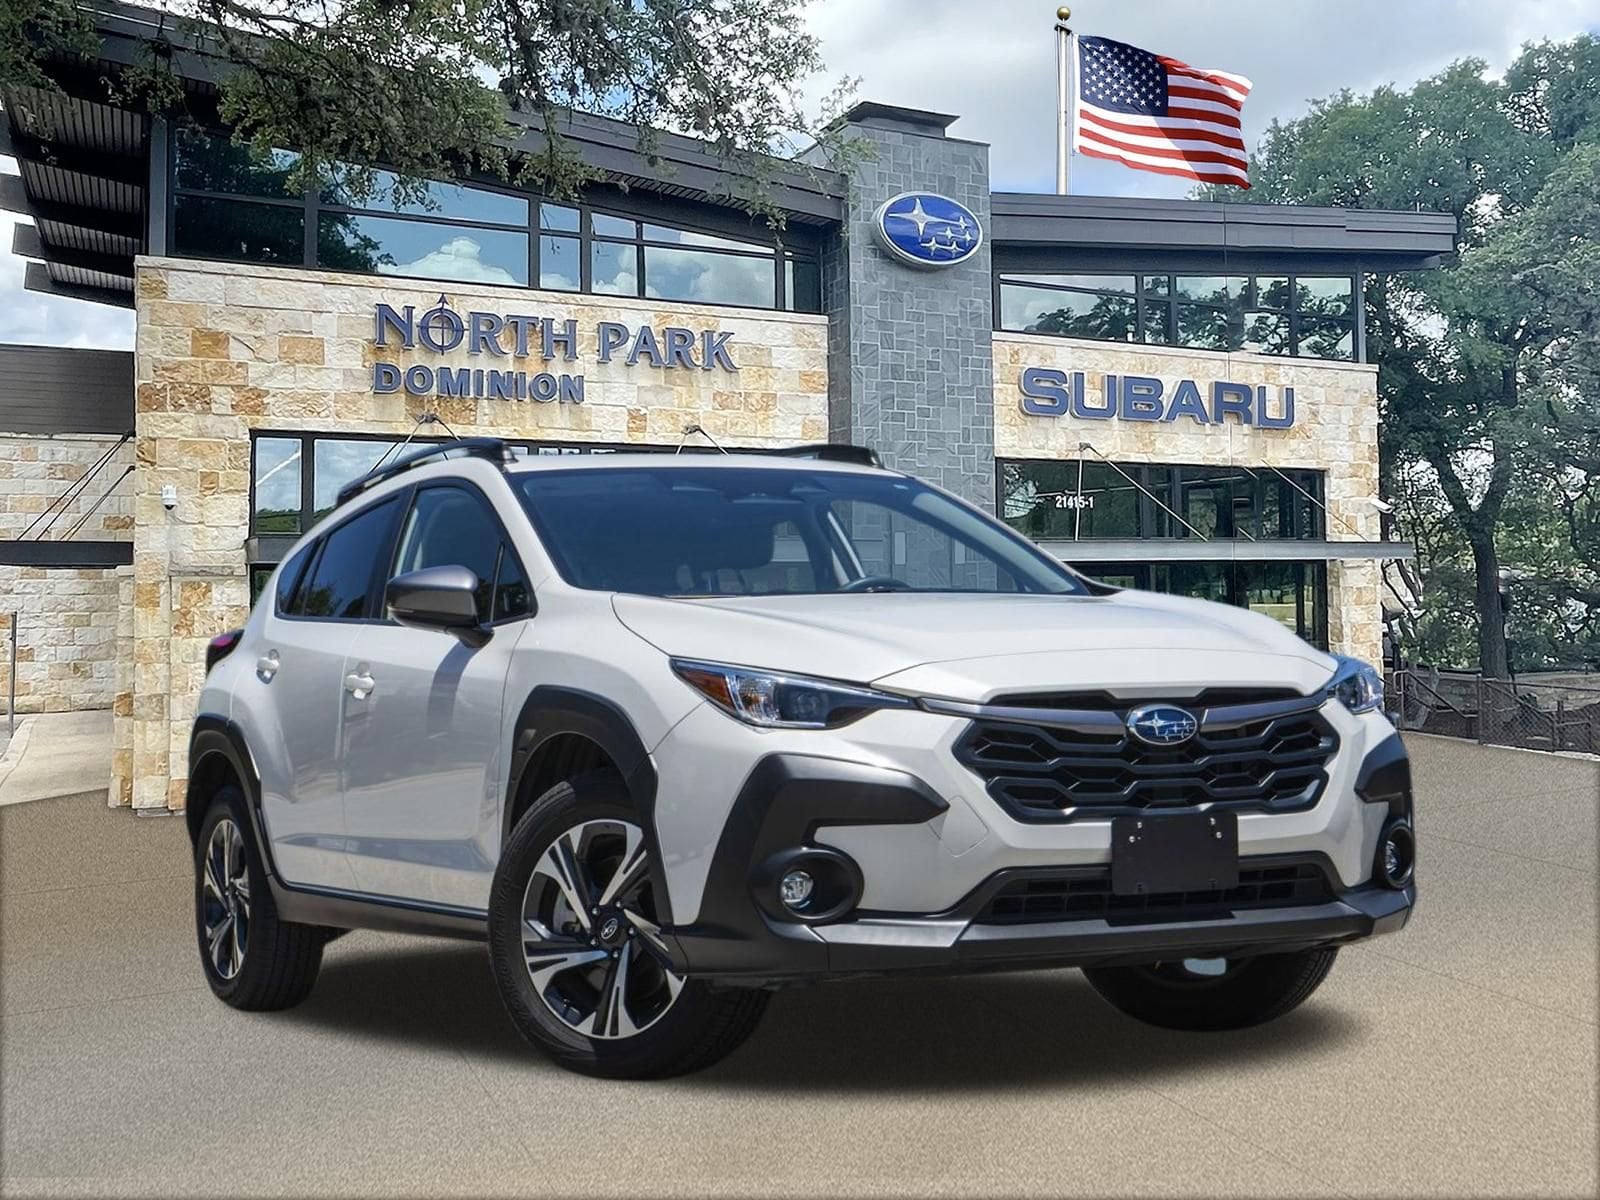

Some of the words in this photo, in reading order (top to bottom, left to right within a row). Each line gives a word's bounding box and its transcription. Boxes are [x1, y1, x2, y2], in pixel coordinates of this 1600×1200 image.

[375, 296, 579, 361] NORTH
[597, 321, 741, 372] PARK
[373, 362, 585, 404] DOMINION
[1019, 367, 1295, 430] SUBARU
